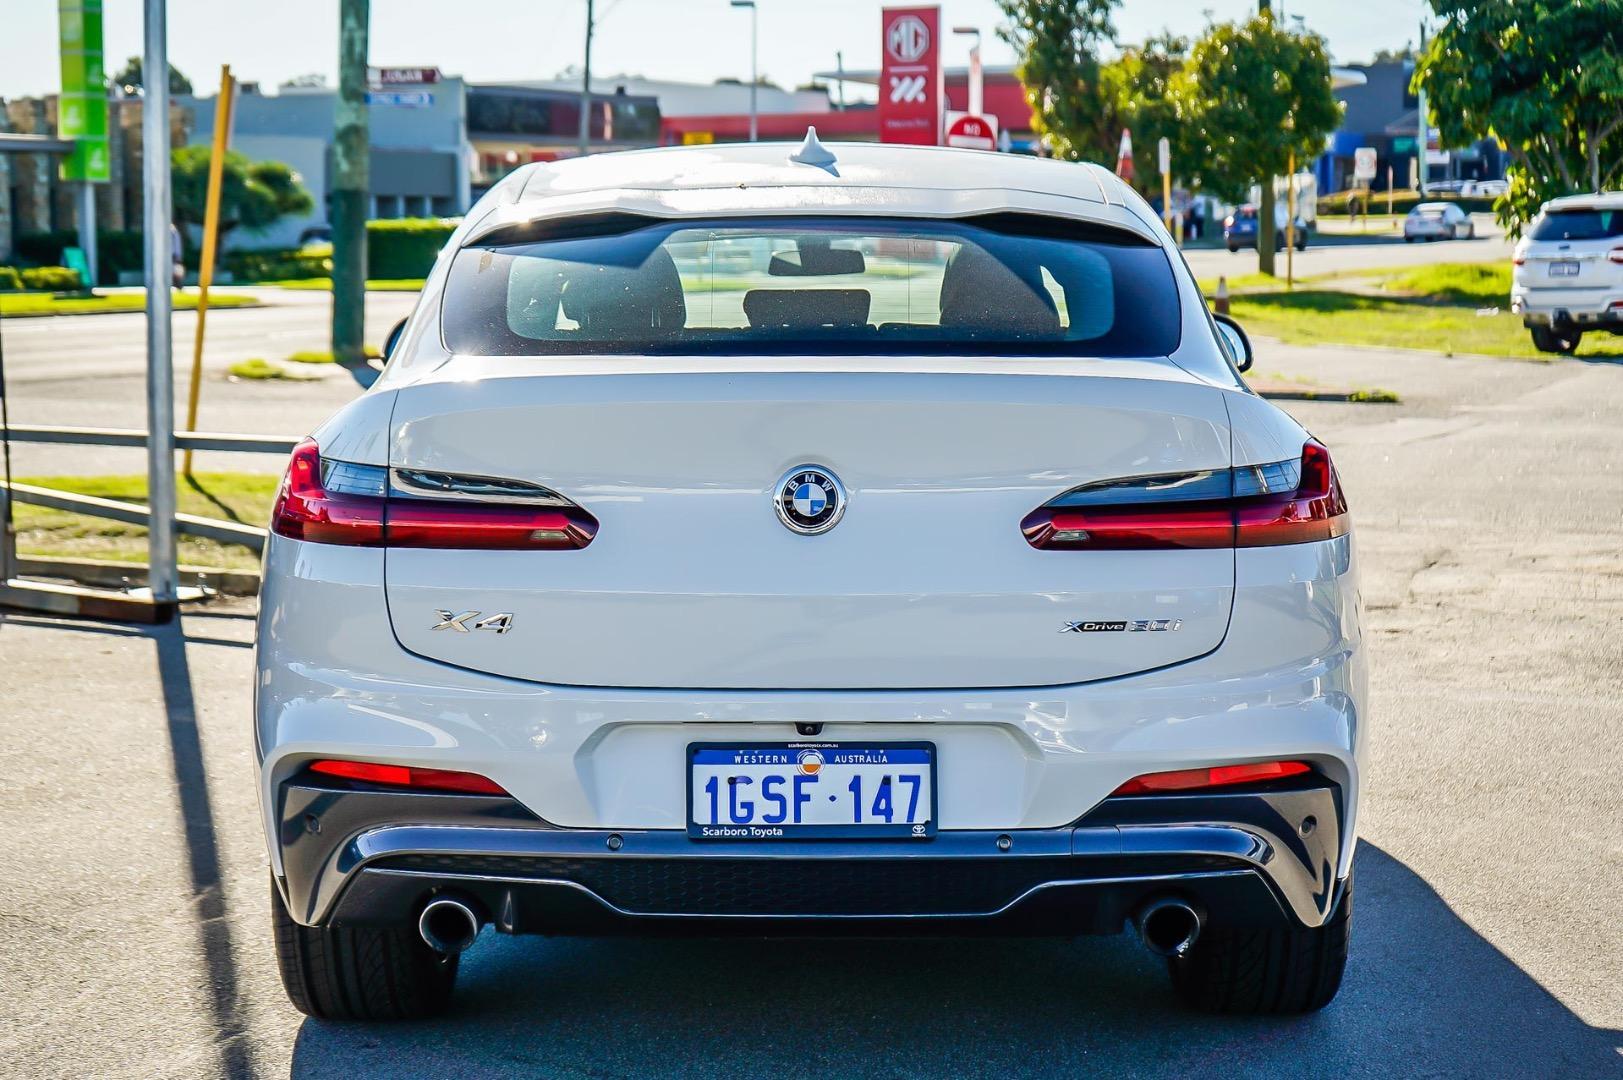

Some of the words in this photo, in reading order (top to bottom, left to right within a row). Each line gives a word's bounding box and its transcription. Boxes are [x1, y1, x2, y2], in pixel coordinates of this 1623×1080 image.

[890, 20, 927, 58] MG
[788, 474, 833, 492] BMW
[430, 608, 513, 634] X4
[734, 755, 788, 763] WESTERN
[834, 754, 888, 763] AUSTRALIA
[702, 827, 748, 836] Scarboro
[750, 827, 783, 838] Toyota
